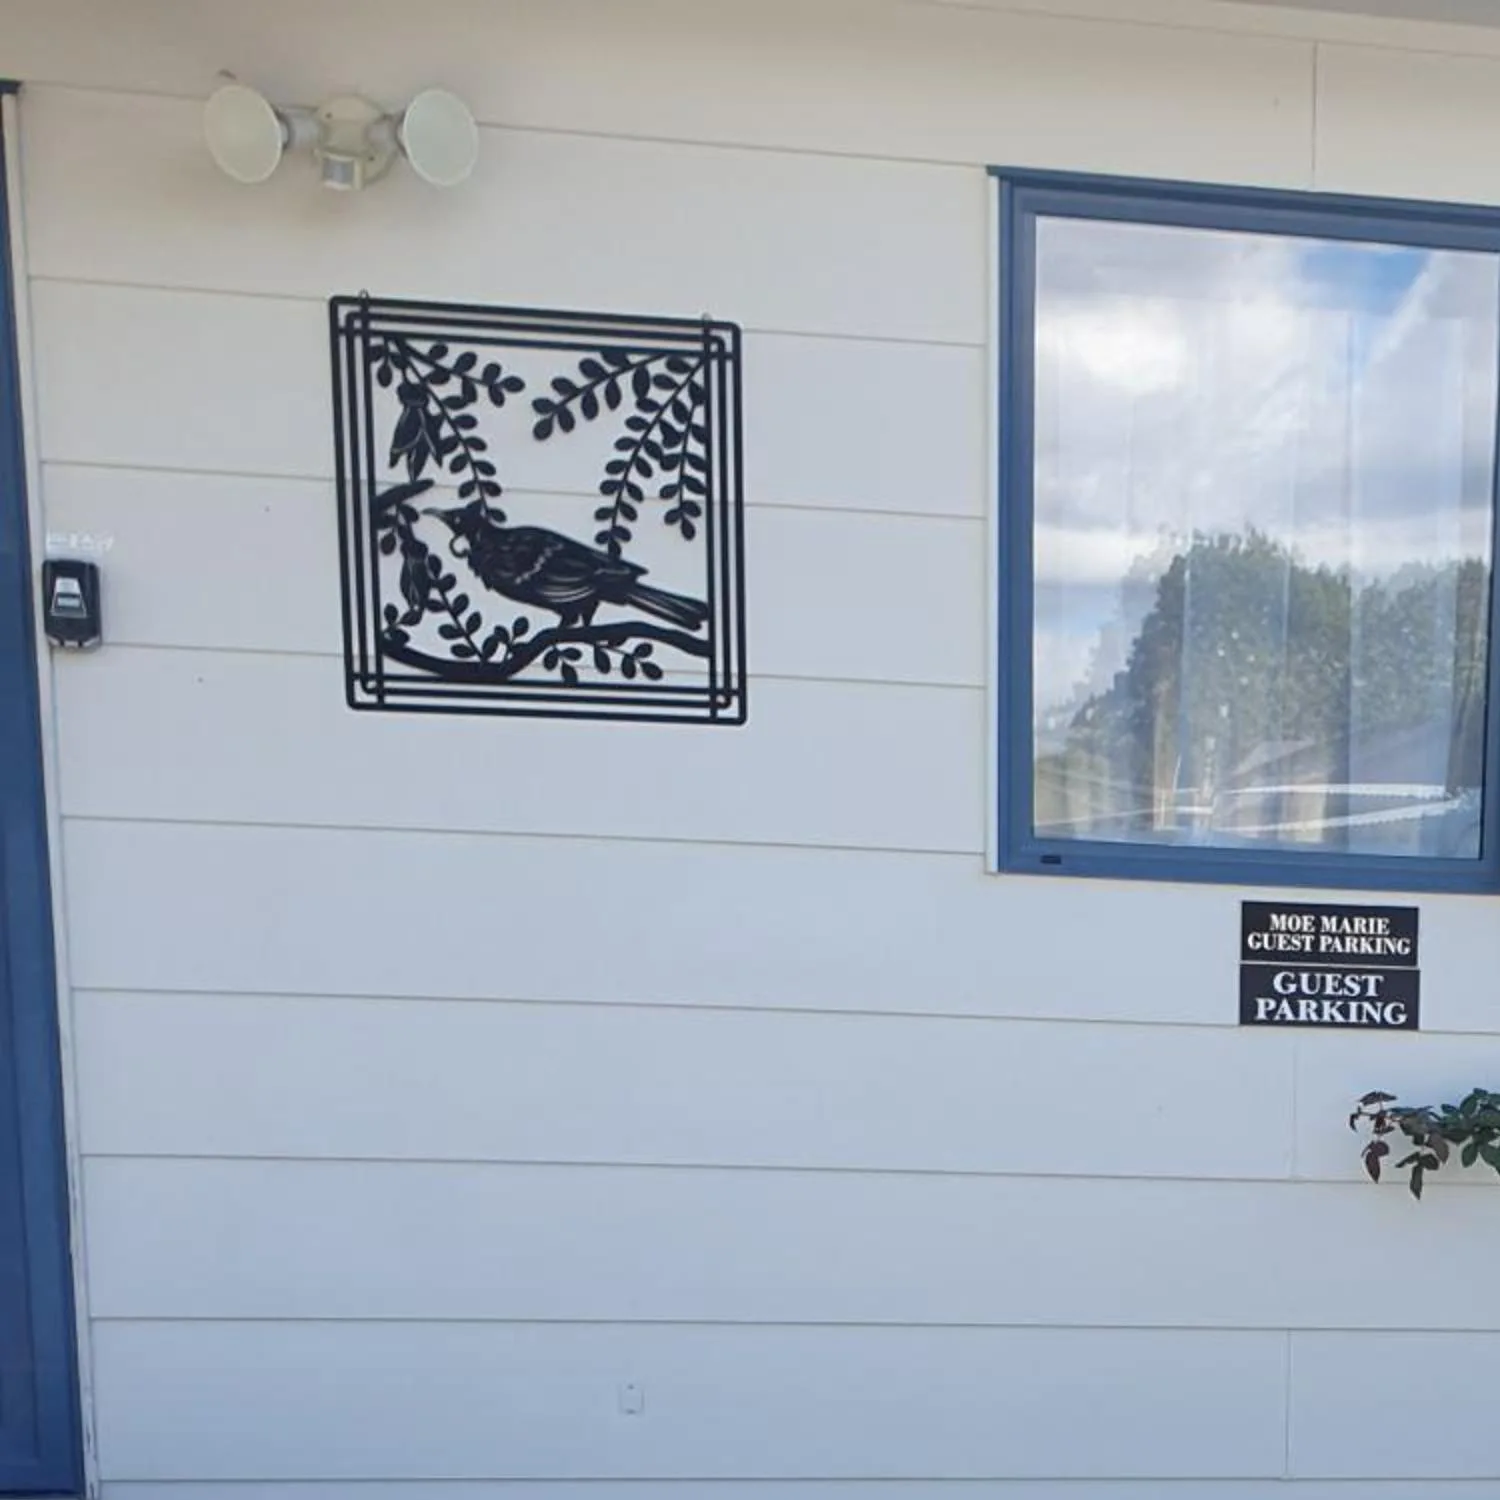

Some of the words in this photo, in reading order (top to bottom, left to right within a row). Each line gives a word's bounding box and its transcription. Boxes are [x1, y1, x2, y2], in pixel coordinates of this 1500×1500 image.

[1270, 913, 1315, 932] MOE
[1320, 915, 1391, 935] MARIE
[1248, 932, 1315, 952] GUEST
[1319, 936, 1411, 955] PARKING
[1273, 971, 1384, 996] GUEST
[1255, 998, 1407, 1025] PARKING
